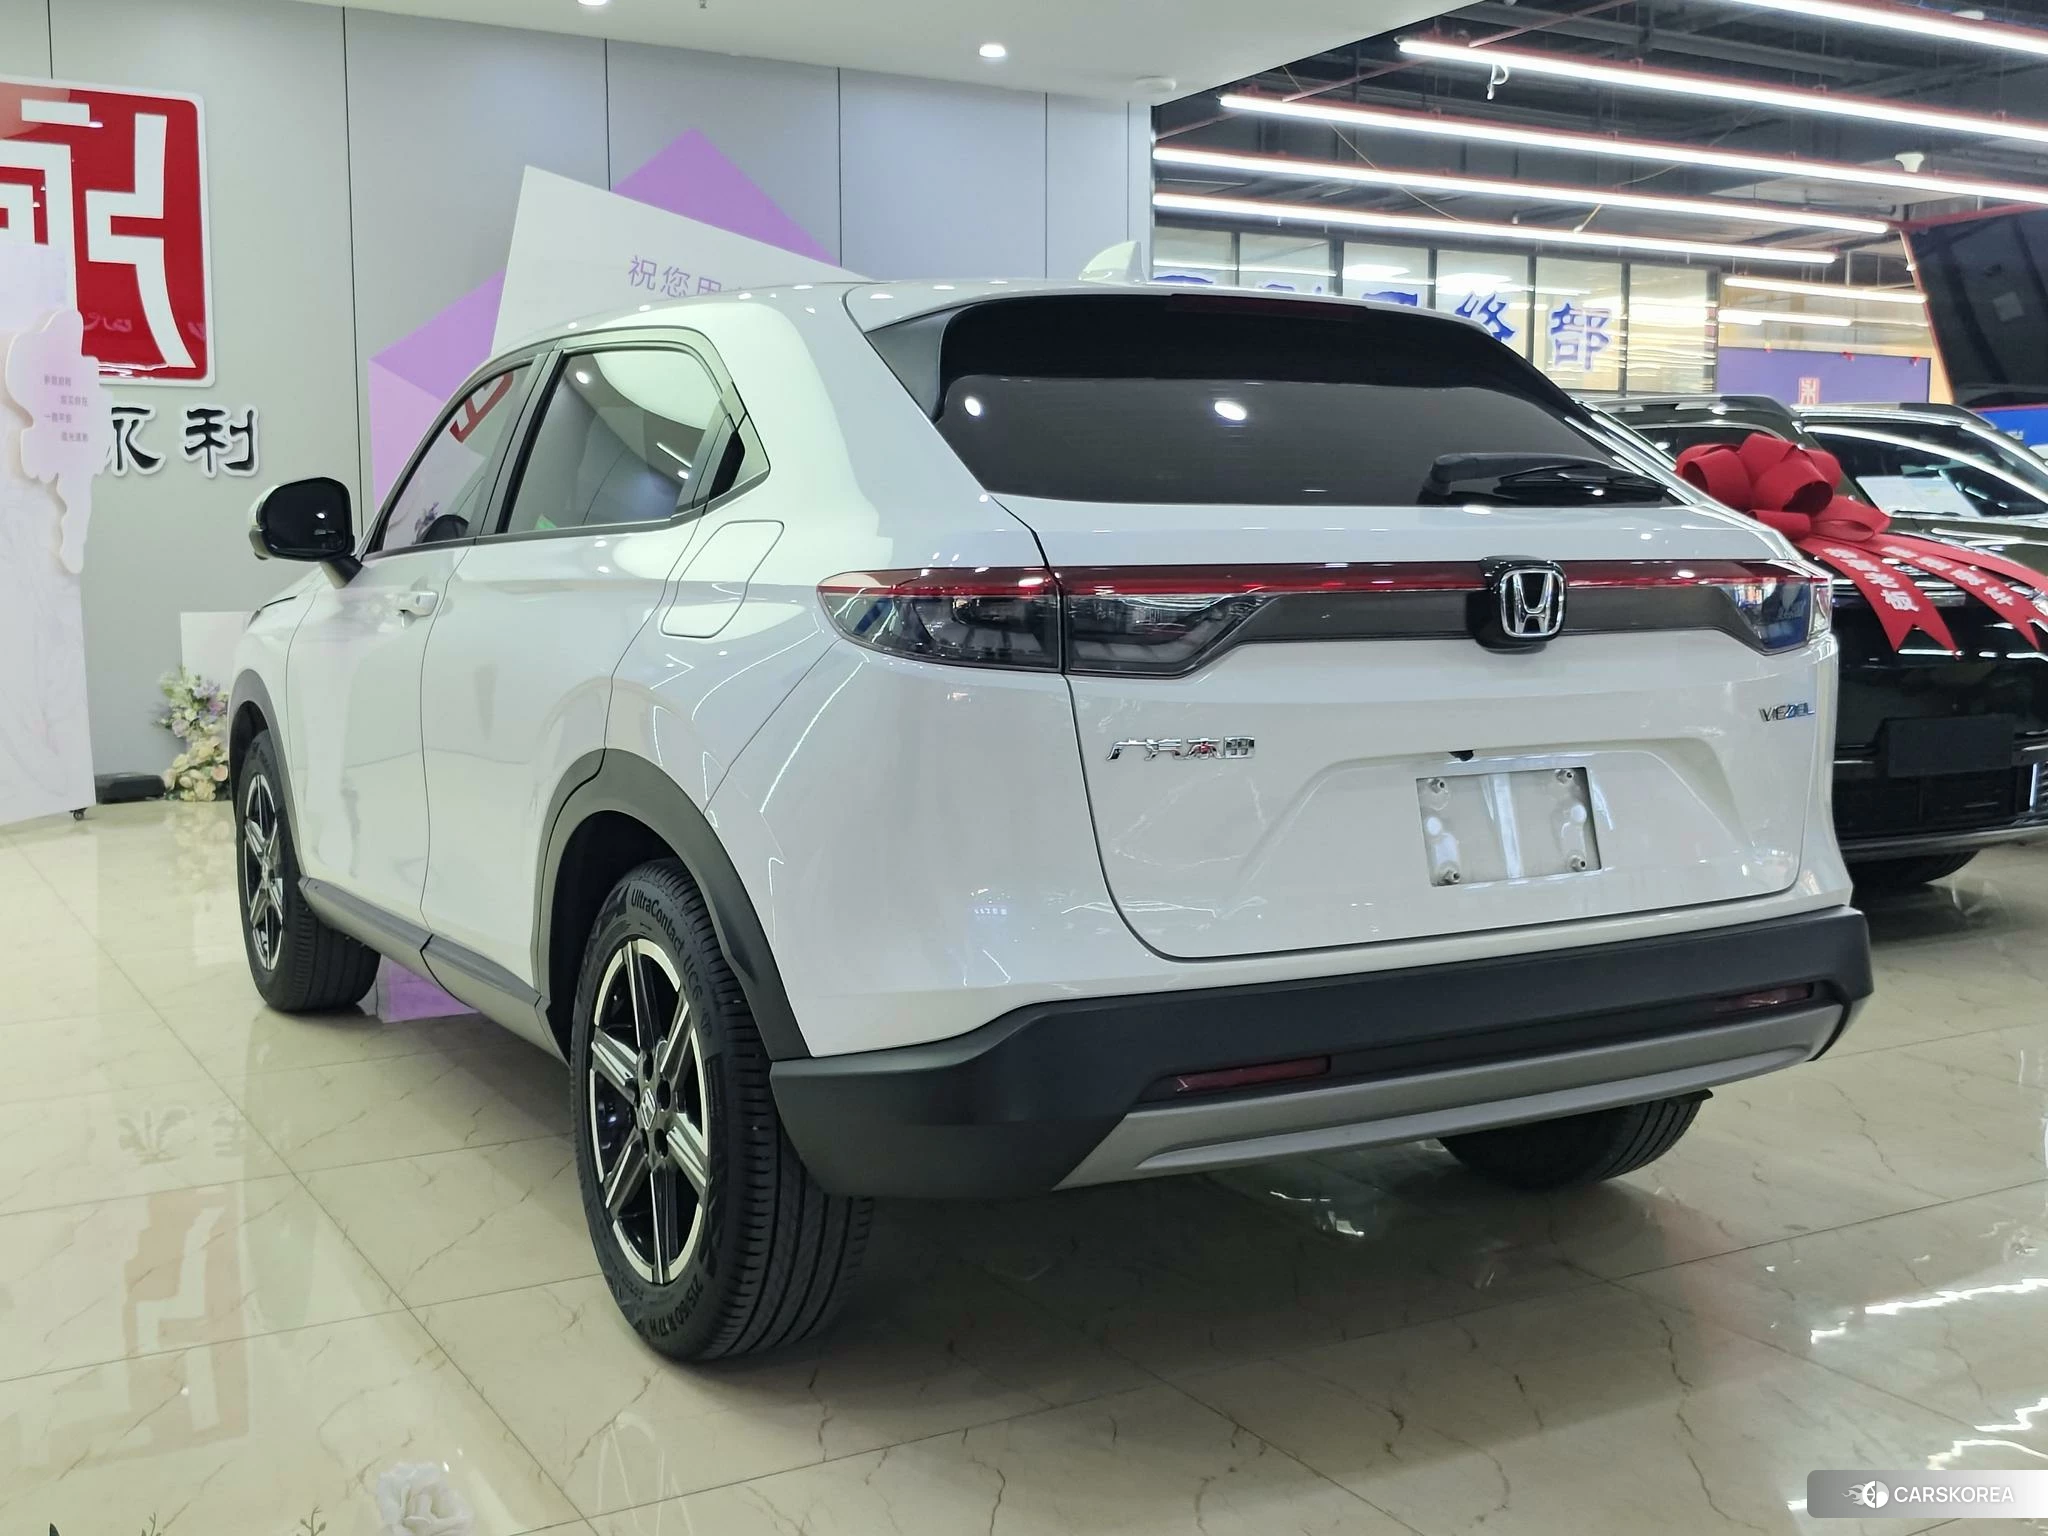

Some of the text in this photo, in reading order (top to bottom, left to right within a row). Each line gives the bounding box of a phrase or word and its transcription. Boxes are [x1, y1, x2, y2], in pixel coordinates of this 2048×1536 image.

[1758, 702, 1815, 722] VEZEL
[1106, 735, 1256, 762] 广汽本田
[630, 888, 686, 958] UltraContact
